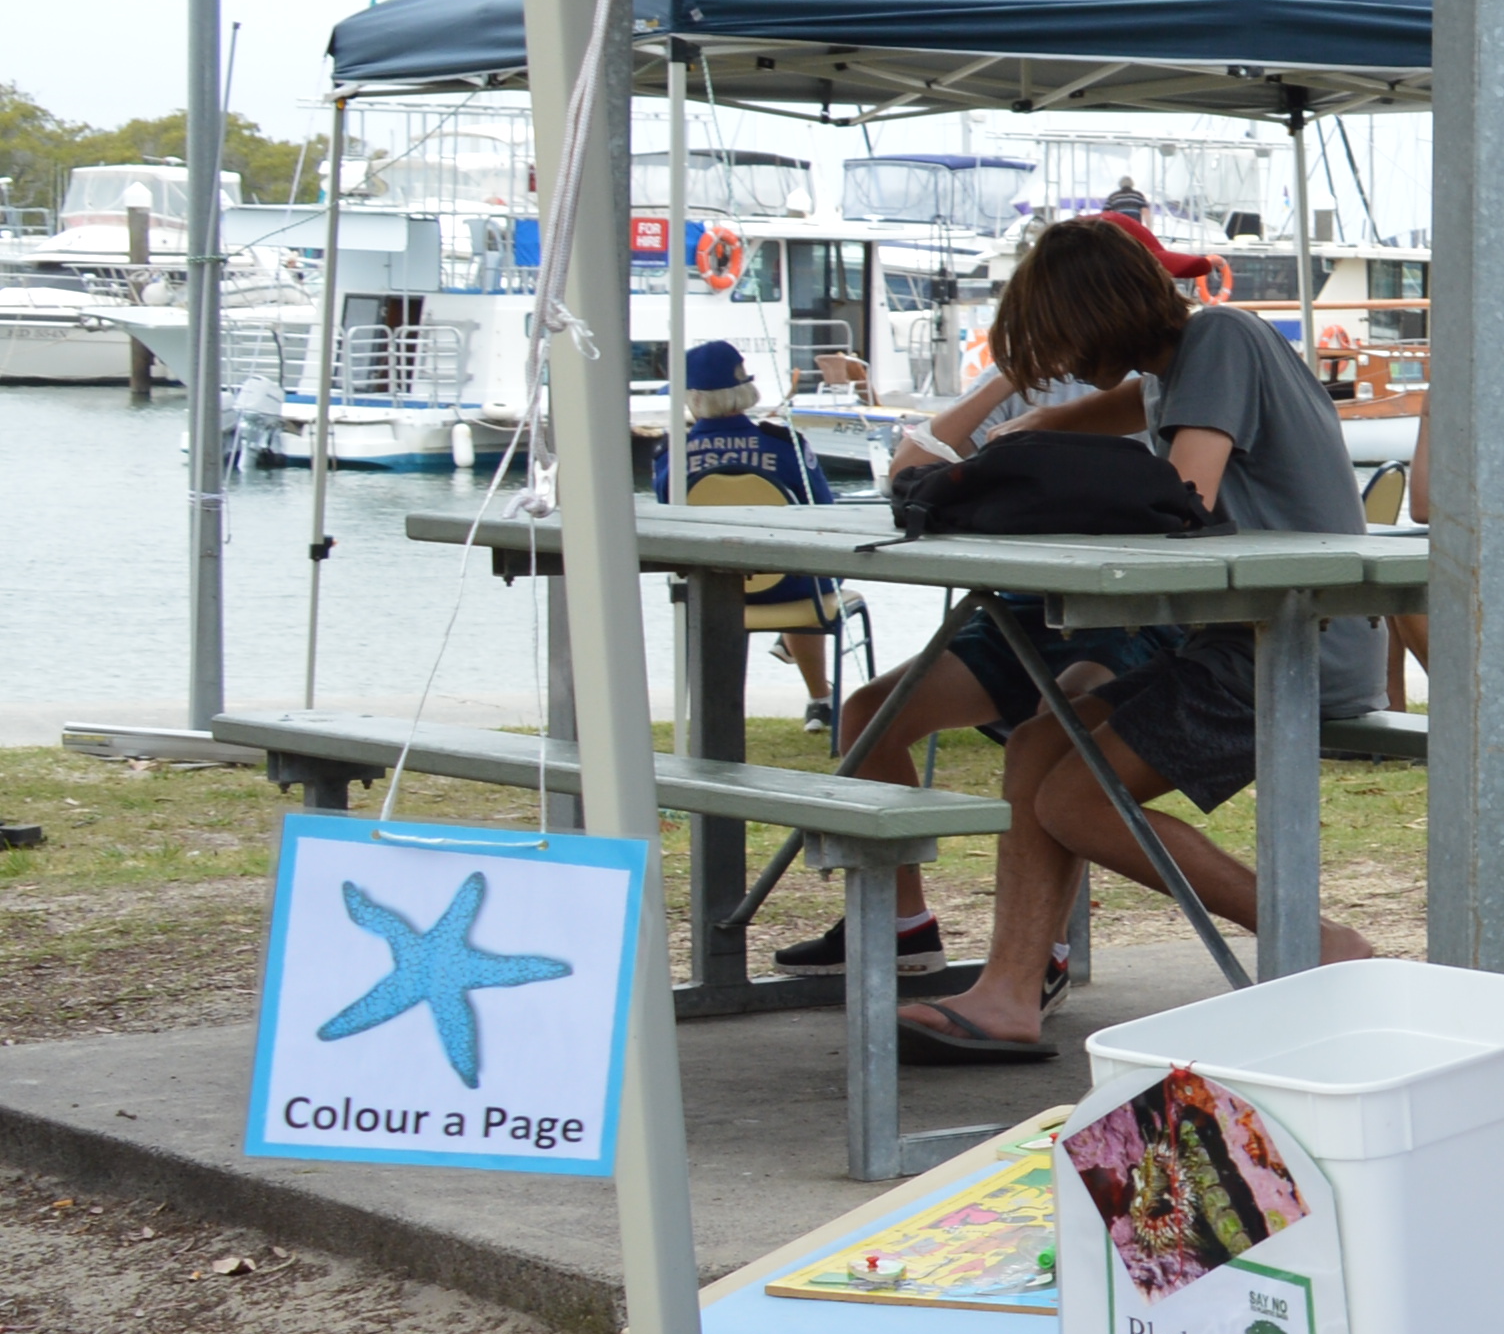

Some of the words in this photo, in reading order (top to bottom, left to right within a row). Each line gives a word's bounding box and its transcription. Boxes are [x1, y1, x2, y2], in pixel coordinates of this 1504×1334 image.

[638, 222, 662, 235] FOR
[636, 235, 662, 248] HIRE
[687, 436, 760, 452] MARINE
[689, 451, 778, 473] ESCUE
[283, 1095, 430, 1135] Colour
[443, 1110, 466, 1137] a
[482, 1106, 585, 1150] Page
[1249, 1290, 1269, 1309] SAY
[1272, 1296, 1288, 1314] NO
